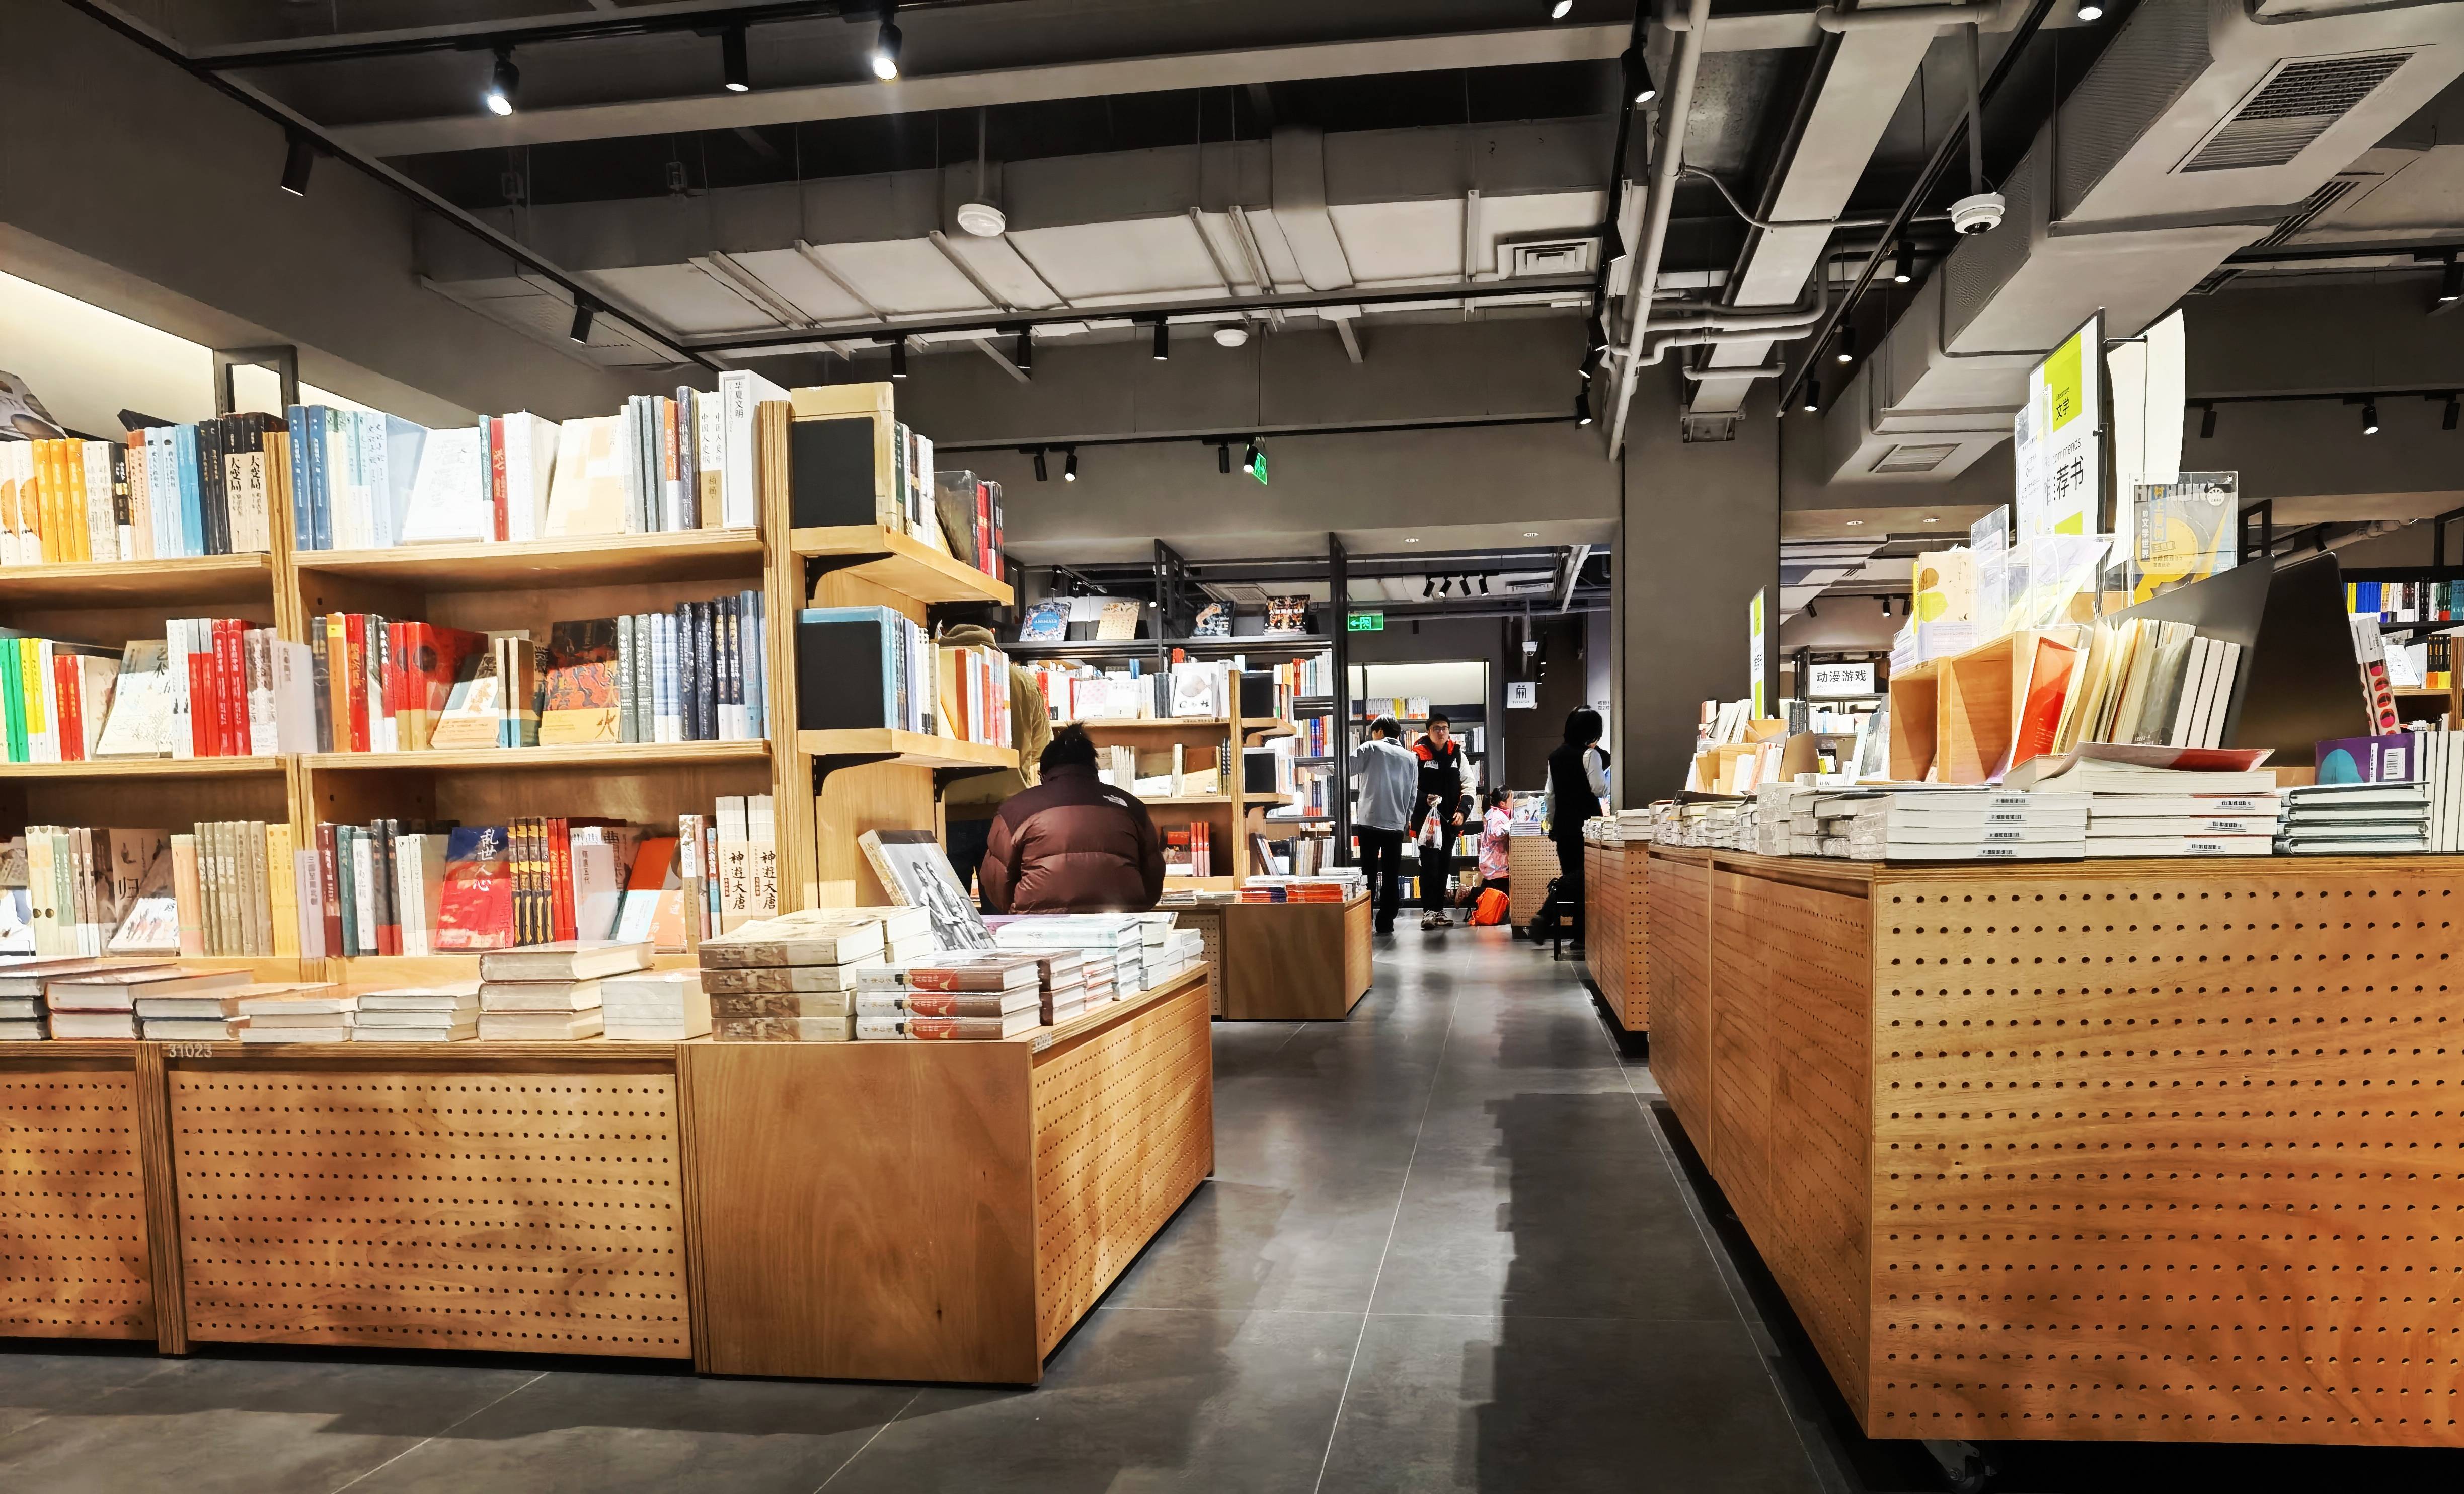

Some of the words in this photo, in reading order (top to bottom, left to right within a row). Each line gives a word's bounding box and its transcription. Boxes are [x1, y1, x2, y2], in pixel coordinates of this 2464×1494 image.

[734, 381, 744, 419] 华夏文明
[2056, 396, 2069, 421] 文学
[2141, 510, 2150, 559] 的文学世界
[1816, 670, 1866, 682] 动漫游戏
[473, 827, 499, 891] 乱世人心
[729, 851, 748, 909] 神遊大唐
[760, 850, 777, 909] 神遊大唐
